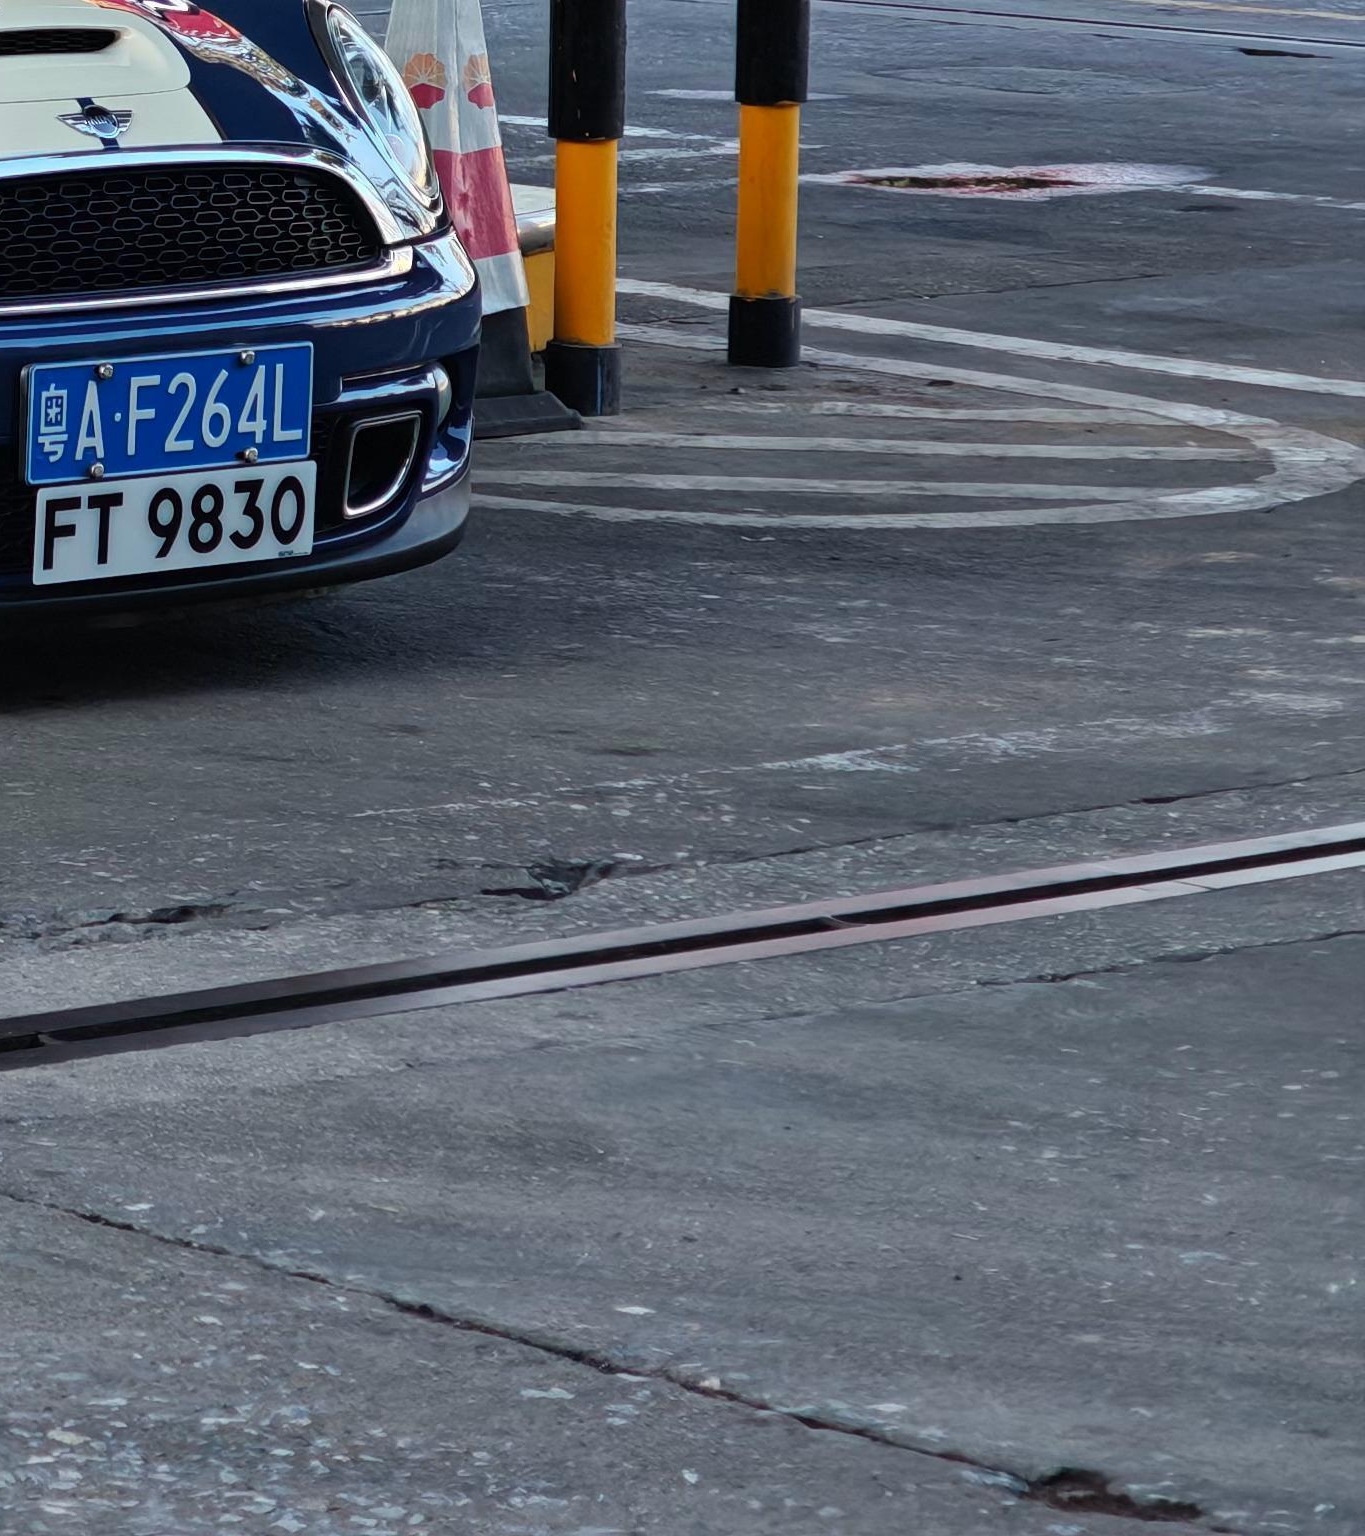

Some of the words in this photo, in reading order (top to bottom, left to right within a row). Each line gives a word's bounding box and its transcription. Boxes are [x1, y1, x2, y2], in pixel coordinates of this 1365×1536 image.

[37, 363, 303, 463] 粤A·F264L
[42, 491, 124, 571] FT
[147, 475, 306, 560] 9830
